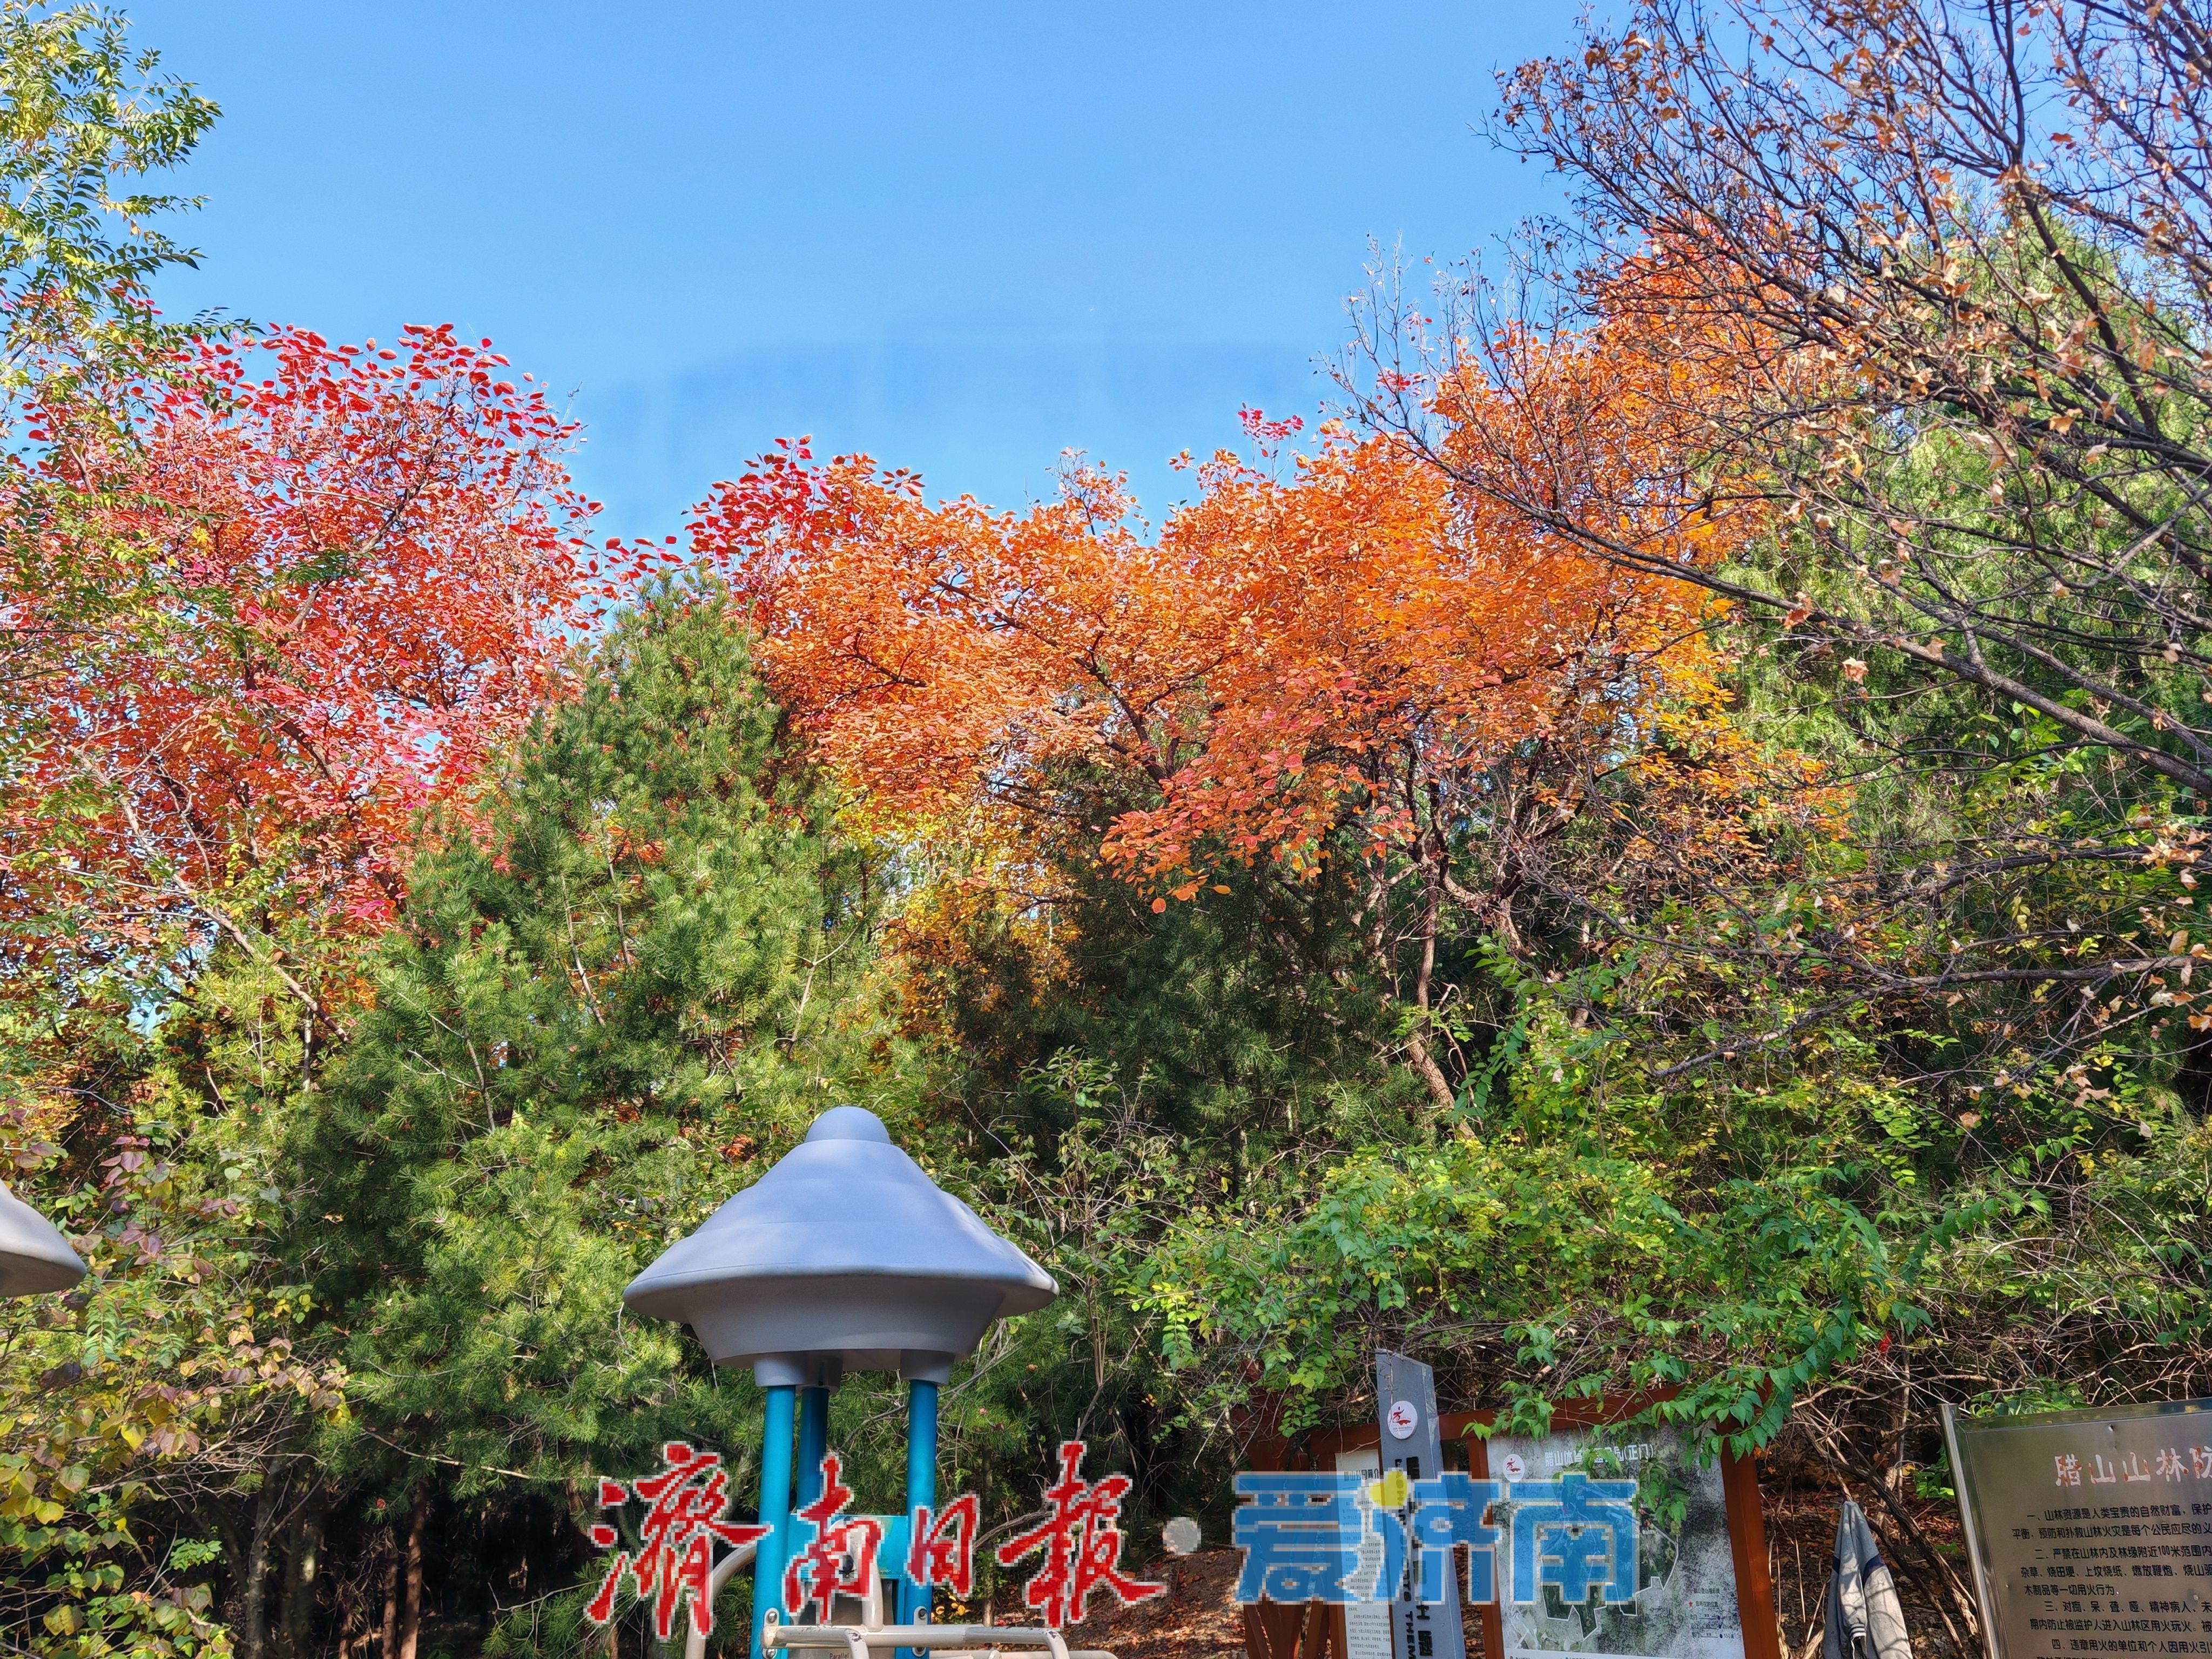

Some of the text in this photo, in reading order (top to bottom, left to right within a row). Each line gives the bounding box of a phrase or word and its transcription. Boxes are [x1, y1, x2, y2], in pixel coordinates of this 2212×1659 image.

[2051, 1638, 2212, 1654] 四、违章用火的单位和个人因用火引
